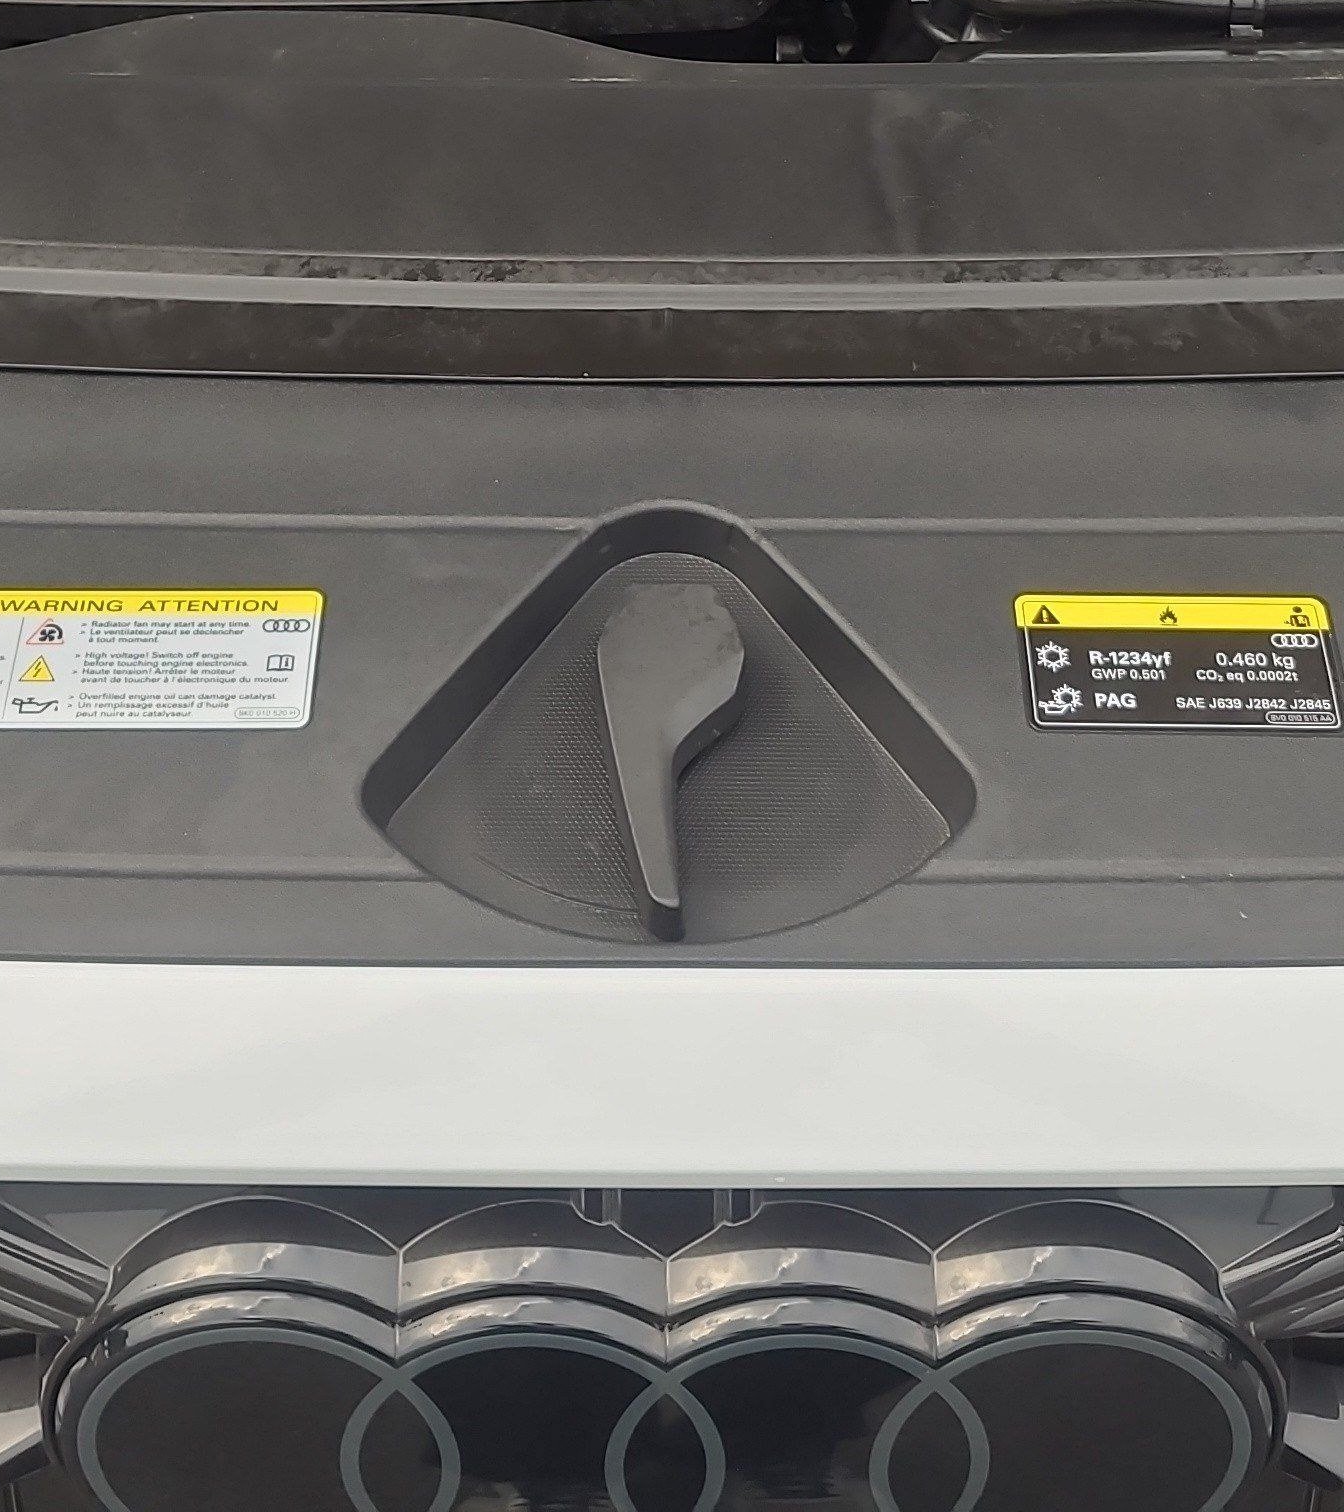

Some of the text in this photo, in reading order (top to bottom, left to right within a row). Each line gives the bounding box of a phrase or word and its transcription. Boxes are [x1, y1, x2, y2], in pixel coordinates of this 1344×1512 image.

[0, 599, 279, 613] WARNING ATTENTION
[91, 620, 131, 628] Radiator
[134, 620, 148, 628] fan
[174, 620, 195, 628] start
[156, 629, 177, 637] peut
[85, 651, 107, 660] High
[110, 651, 149, 660] voltage!
[152, 651, 183, 660] Switch
[186, 651, 199, 659] off
[1088, 650, 1294, 669] R-1234yf 0.460 kg
[117, 660, 158, 668] touching
[161, 660, 193, 668] engine
[1091, 668, 1166, 680] GWP 0.501
[1226, 671, 1244, 683] eq
[1246, 670, 1298, 682] 0.0002t
[79, 692, 126, 700] Overfilled
[128, 693, 161, 701] engine
[198, 692, 237, 701] damage
[1094, 692, 1137, 709] PAG
[95, 701, 153, 709] remplissage
[1175, 697, 1331, 710] SAE J639 J2842 J2845
